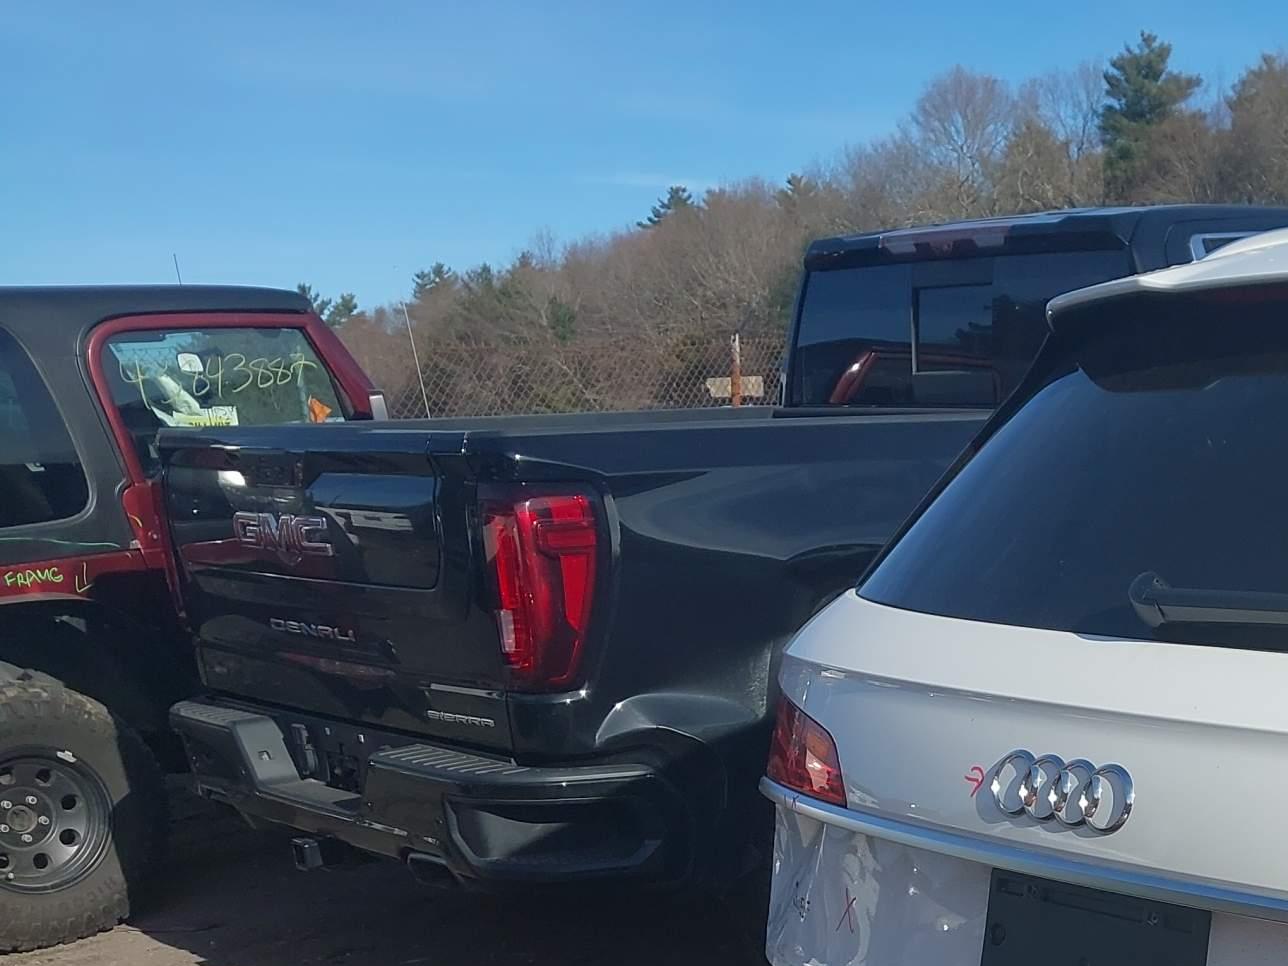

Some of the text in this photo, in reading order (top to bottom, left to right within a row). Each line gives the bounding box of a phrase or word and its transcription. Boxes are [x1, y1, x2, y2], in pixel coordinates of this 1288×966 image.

[233, 511, 335, 557] GMC
[270, 617, 356, 642] DENALI
[427, 710, 495, 728] SIERRA
